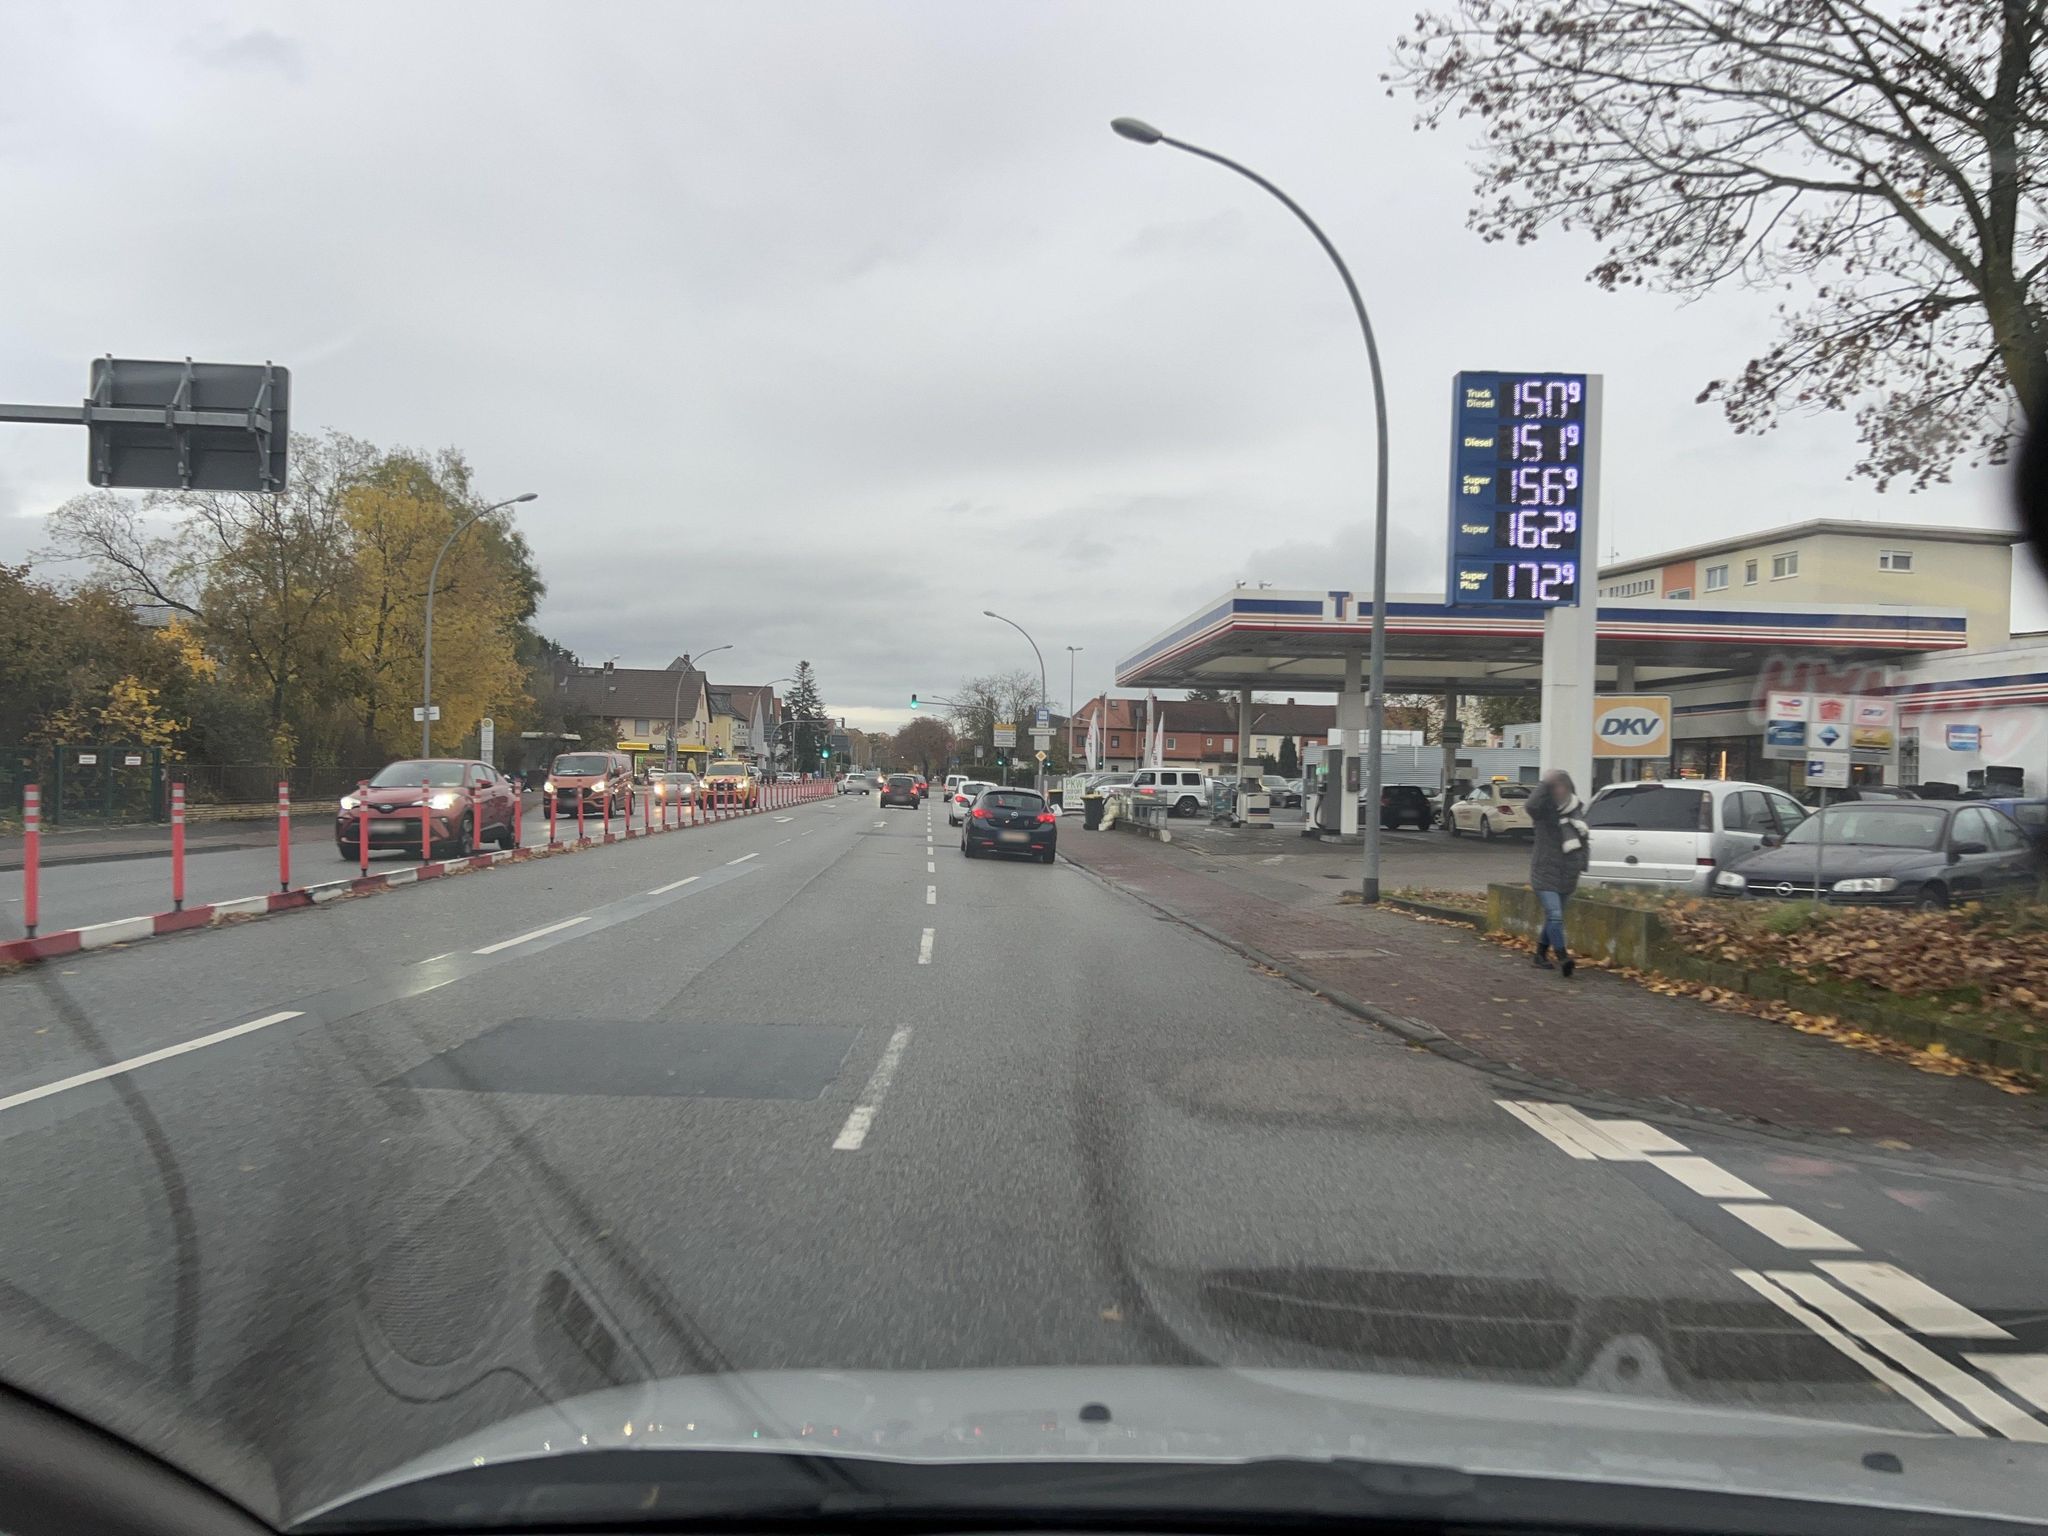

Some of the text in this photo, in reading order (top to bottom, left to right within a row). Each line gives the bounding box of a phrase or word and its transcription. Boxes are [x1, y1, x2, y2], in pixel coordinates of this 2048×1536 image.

[1466, 388, 1491, 398] Truck
[1466, 399, 1495, 408] Diesel
[1464, 438, 1493, 448] Diesel
[1463, 475, 1491, 486] Super
[1463, 486, 1480, 494] E10
[1461, 524, 1490, 535] Super
[1460, 571, 1488, 582] Super
[1460, 580, 1480, 590] Plus
[1601, 718, 1660, 735] DKV
